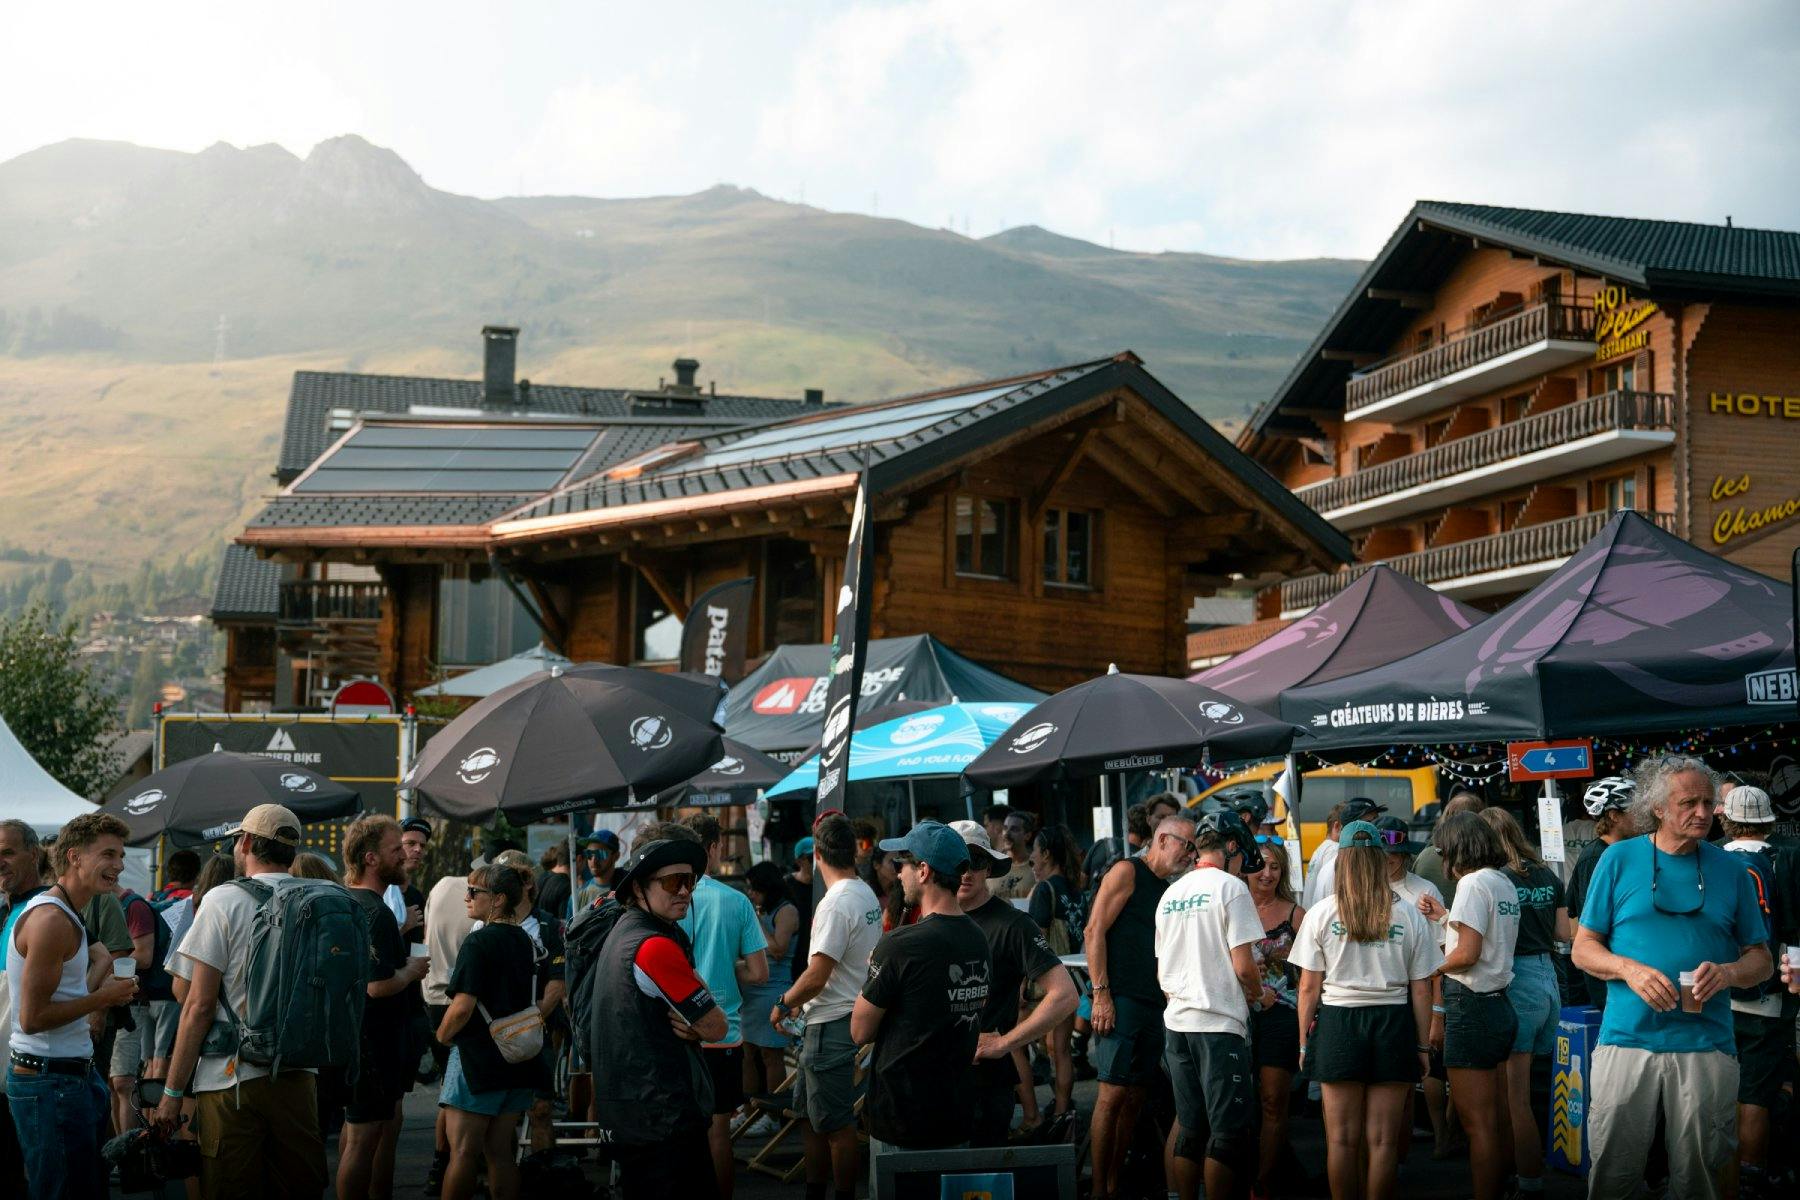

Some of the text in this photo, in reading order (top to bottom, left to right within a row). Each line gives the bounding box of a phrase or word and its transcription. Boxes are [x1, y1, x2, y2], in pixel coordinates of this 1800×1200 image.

[1710, 391, 1800, 418] HOTE
[1330, 695, 1464, 728] CRÉATEURS DE BIÈRES
[293, 752, 321, 764] BIKE
